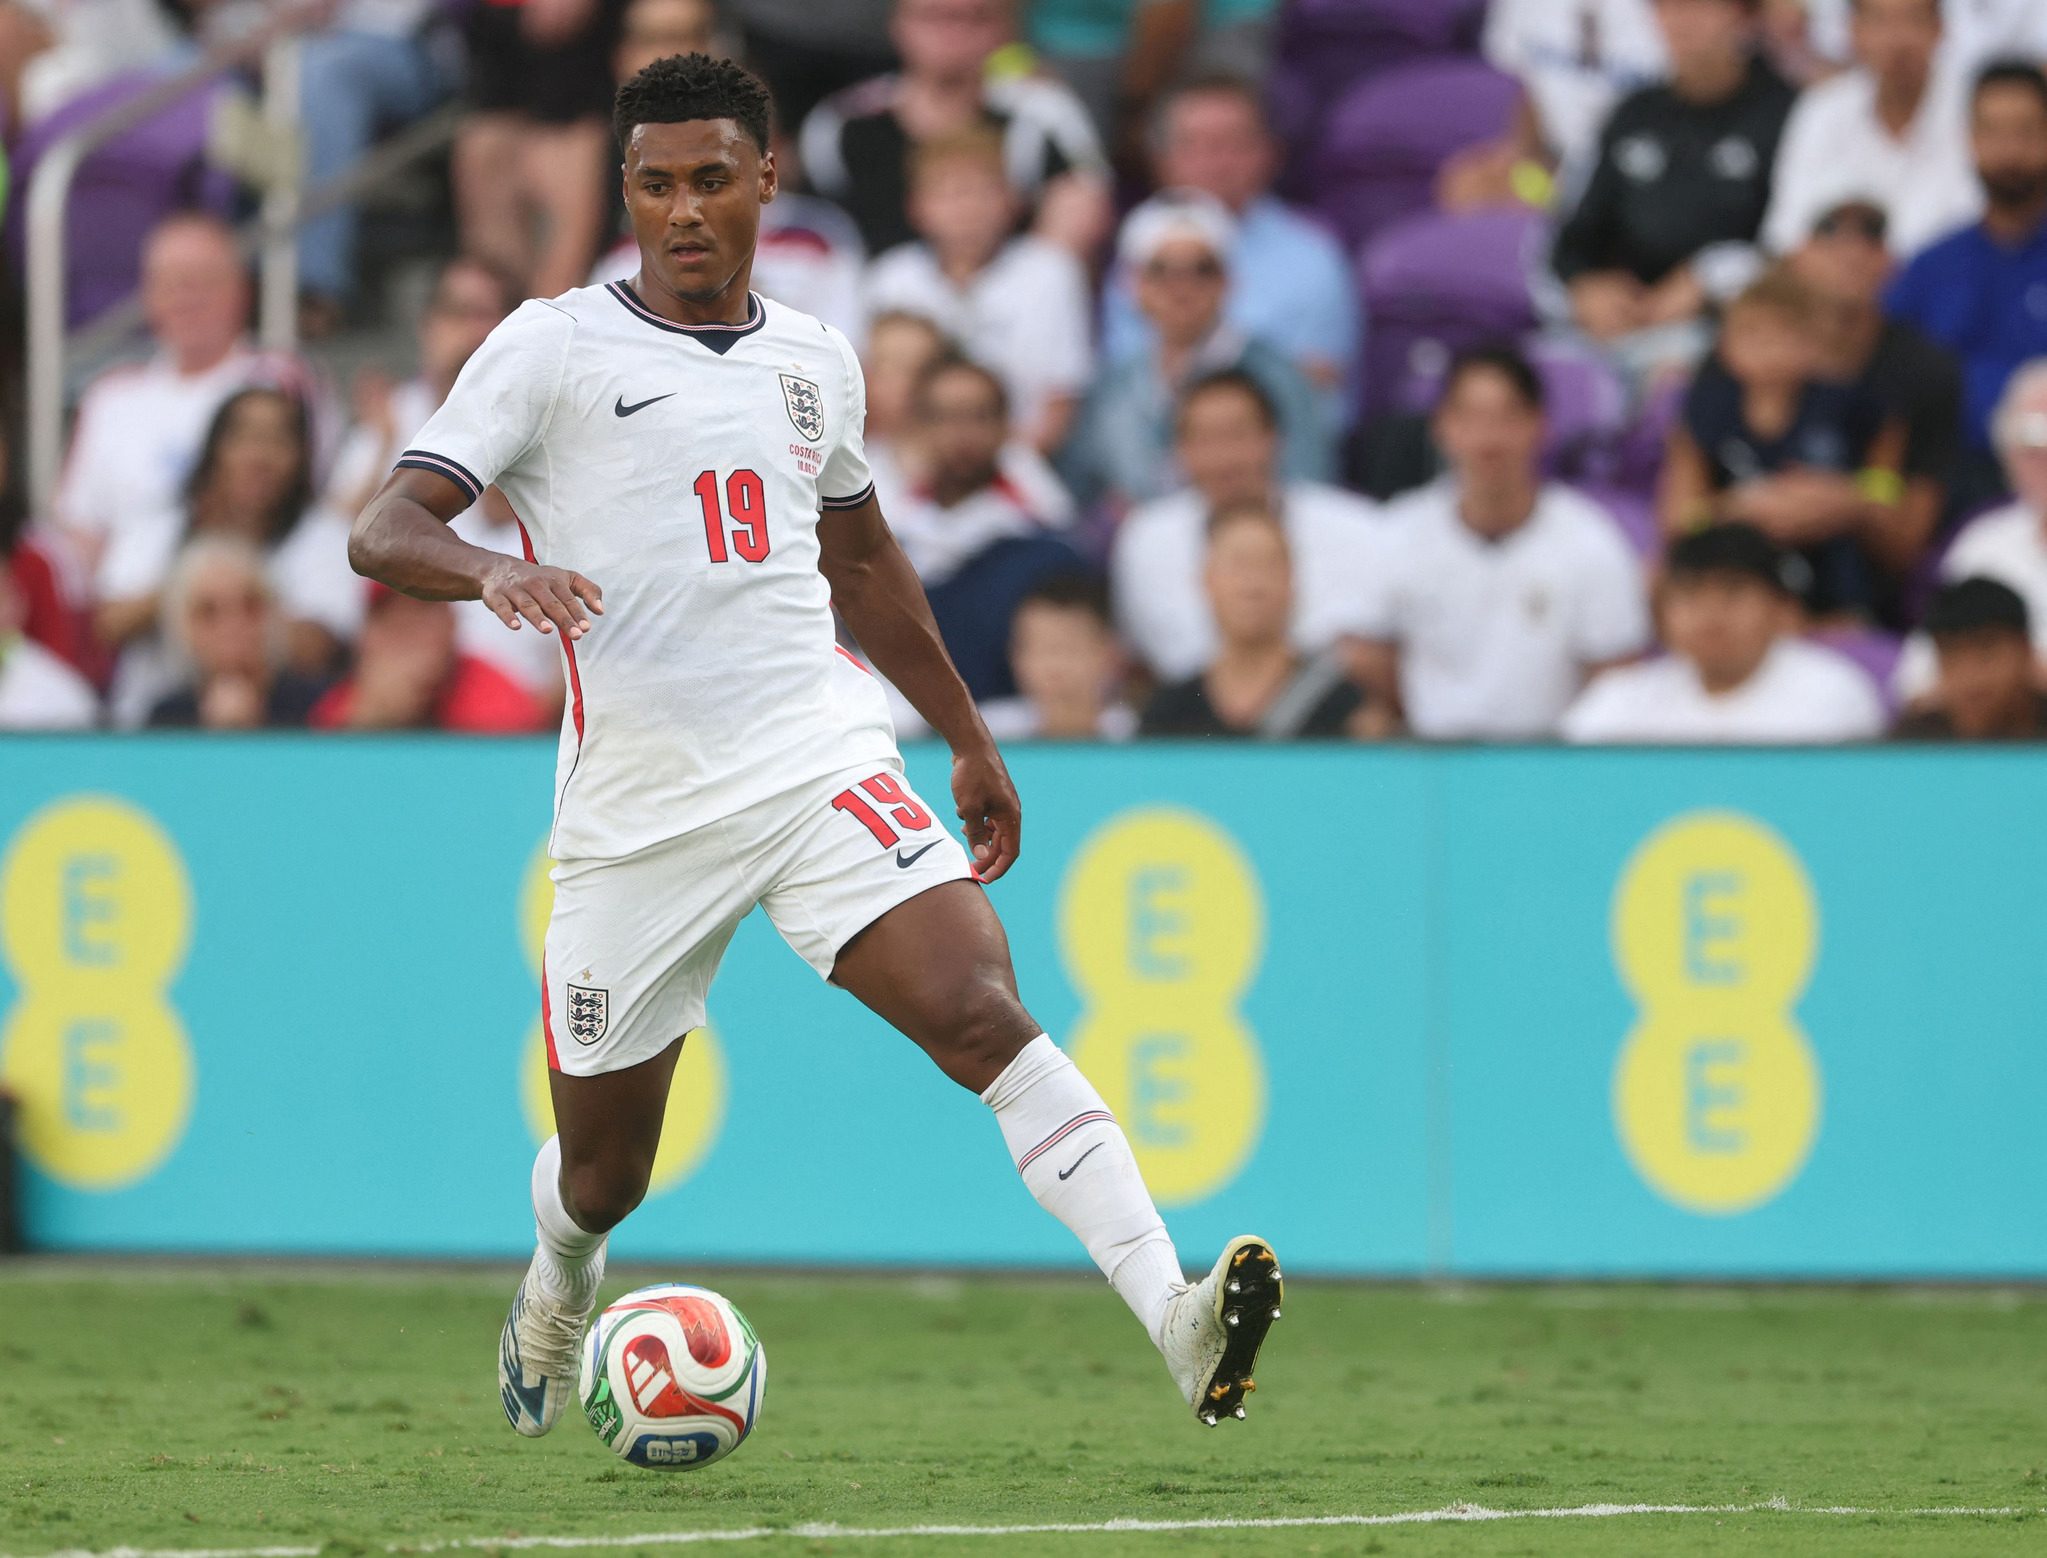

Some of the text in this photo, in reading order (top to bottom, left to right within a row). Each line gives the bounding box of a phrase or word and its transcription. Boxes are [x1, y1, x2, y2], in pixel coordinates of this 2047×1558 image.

[789, 443, 812, 460] COSTA
[693, 469, 771, 563] 19
[831, 772, 932, 850] 19
